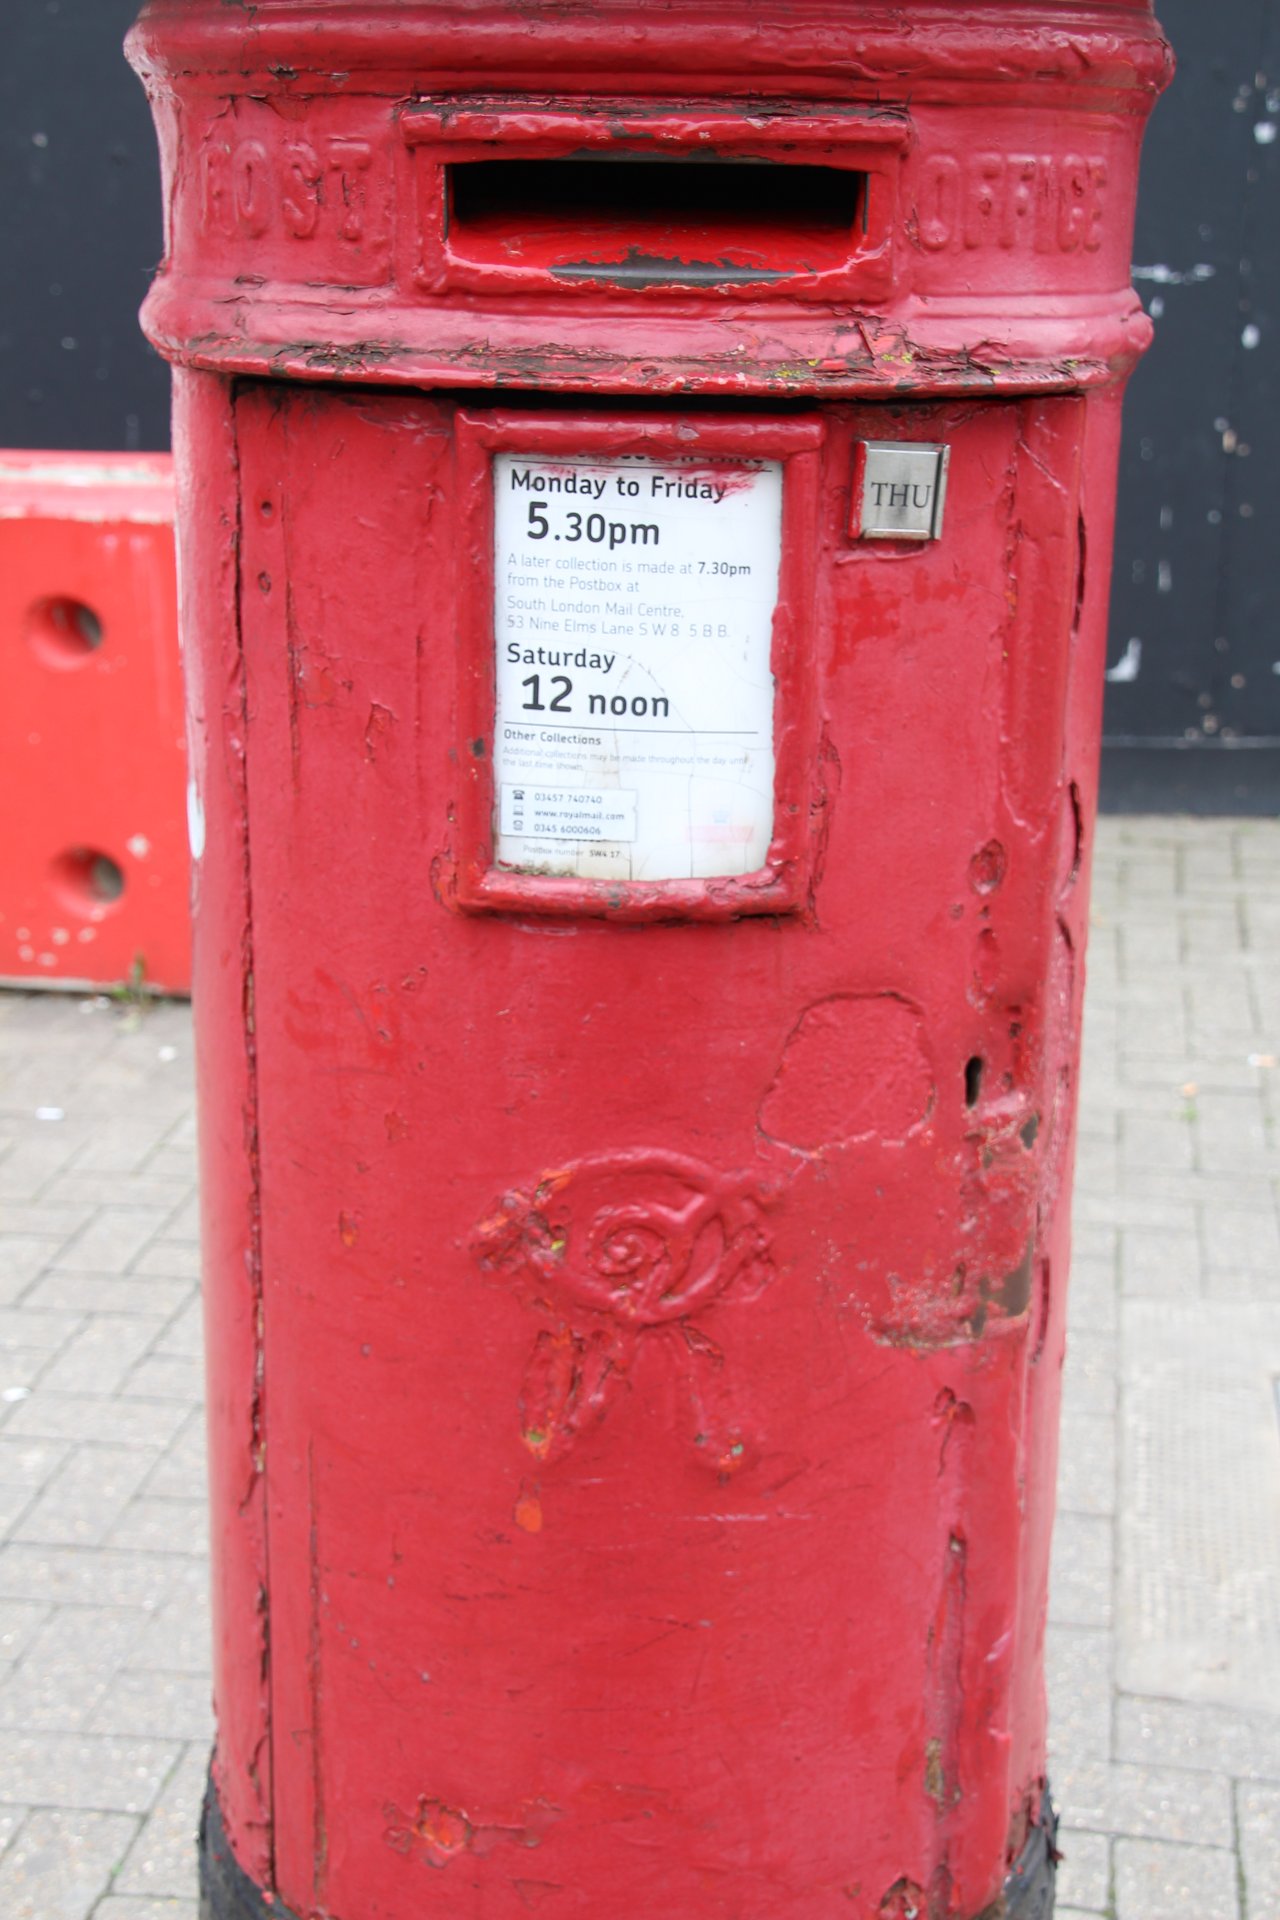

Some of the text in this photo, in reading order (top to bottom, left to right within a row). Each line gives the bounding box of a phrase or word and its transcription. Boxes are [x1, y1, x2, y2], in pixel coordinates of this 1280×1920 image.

[918, 152, 1107, 251] OFFICE
[511, 468, 727, 504] Monday to Friday
[871, 482, 932, 508] THU
[527, 501, 660, 551] 5.30pm
[507, 552, 751, 578] A later collection is made at 7.30pm
[507, 572, 640, 593] from the Postbox at
[507, 595, 546, 611] South
[551, 599, 600, 614] London
[605, 602, 633, 616] Mail
[507, 615, 524, 629] 53
[529, 616, 559, 632] Nine
[564, 619, 597, 634] Elms
[601, 622, 634, 635] Lane
[507, 643, 616, 673] Saturday
[522, 674, 669, 717] 12 noon
[504, 729, 602, 745] Other Collections
[534, 810, 625, 821] www.royalmail.com
[534, 823, 557, 833] 0345
